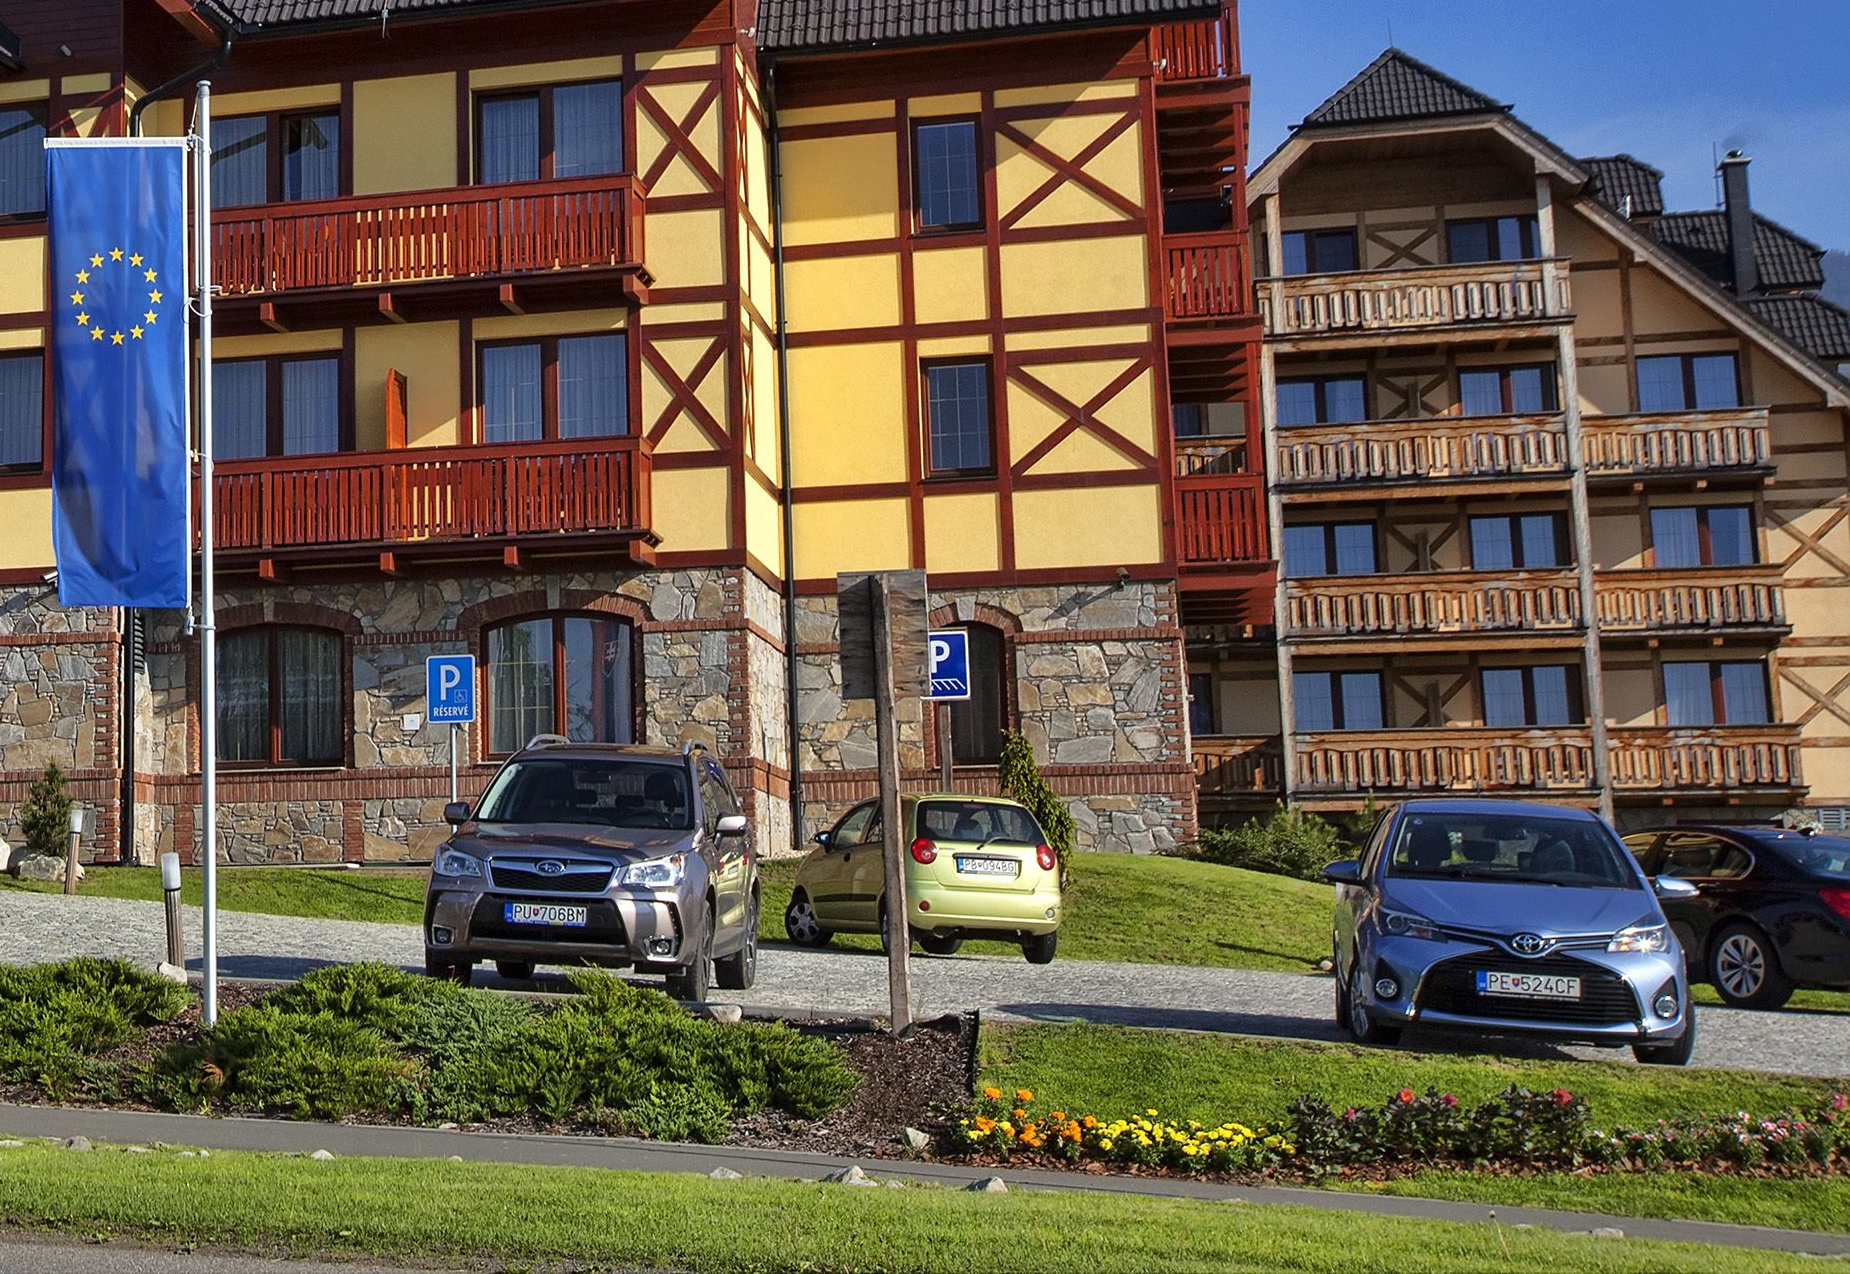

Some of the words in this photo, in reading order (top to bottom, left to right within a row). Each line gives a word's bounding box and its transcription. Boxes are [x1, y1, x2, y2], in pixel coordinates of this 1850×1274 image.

[930, 640, 951, 674] P
[440, 664, 461, 701] P
[433, 704, 469, 717] RÉSERVÉ
